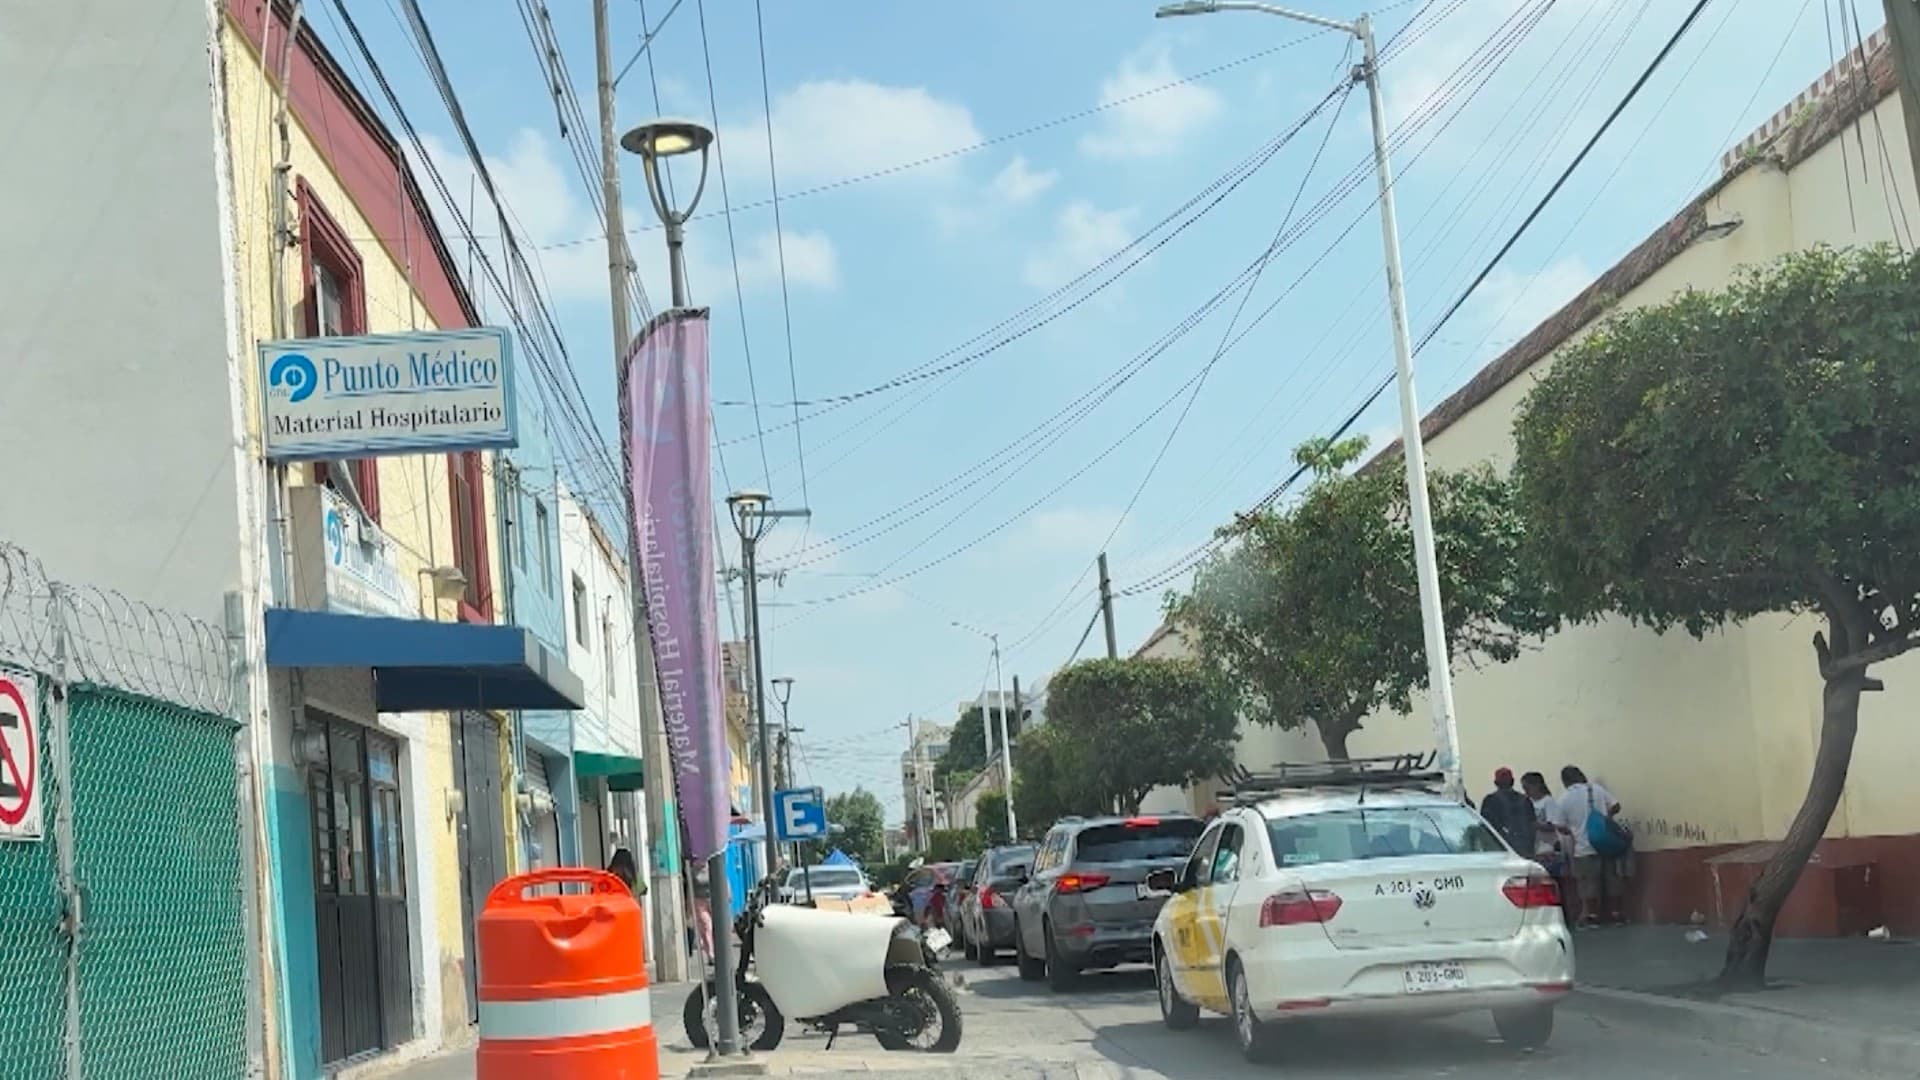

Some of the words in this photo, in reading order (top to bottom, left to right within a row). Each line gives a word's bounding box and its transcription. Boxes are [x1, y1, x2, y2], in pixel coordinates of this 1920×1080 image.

[324, 356, 399, 392] Punto
[409, 349, 497, 387] Médico
[274, 409, 363, 435] Material
[371, 401, 501, 432] Hospitalario
[783, 794, 818, 836] E
